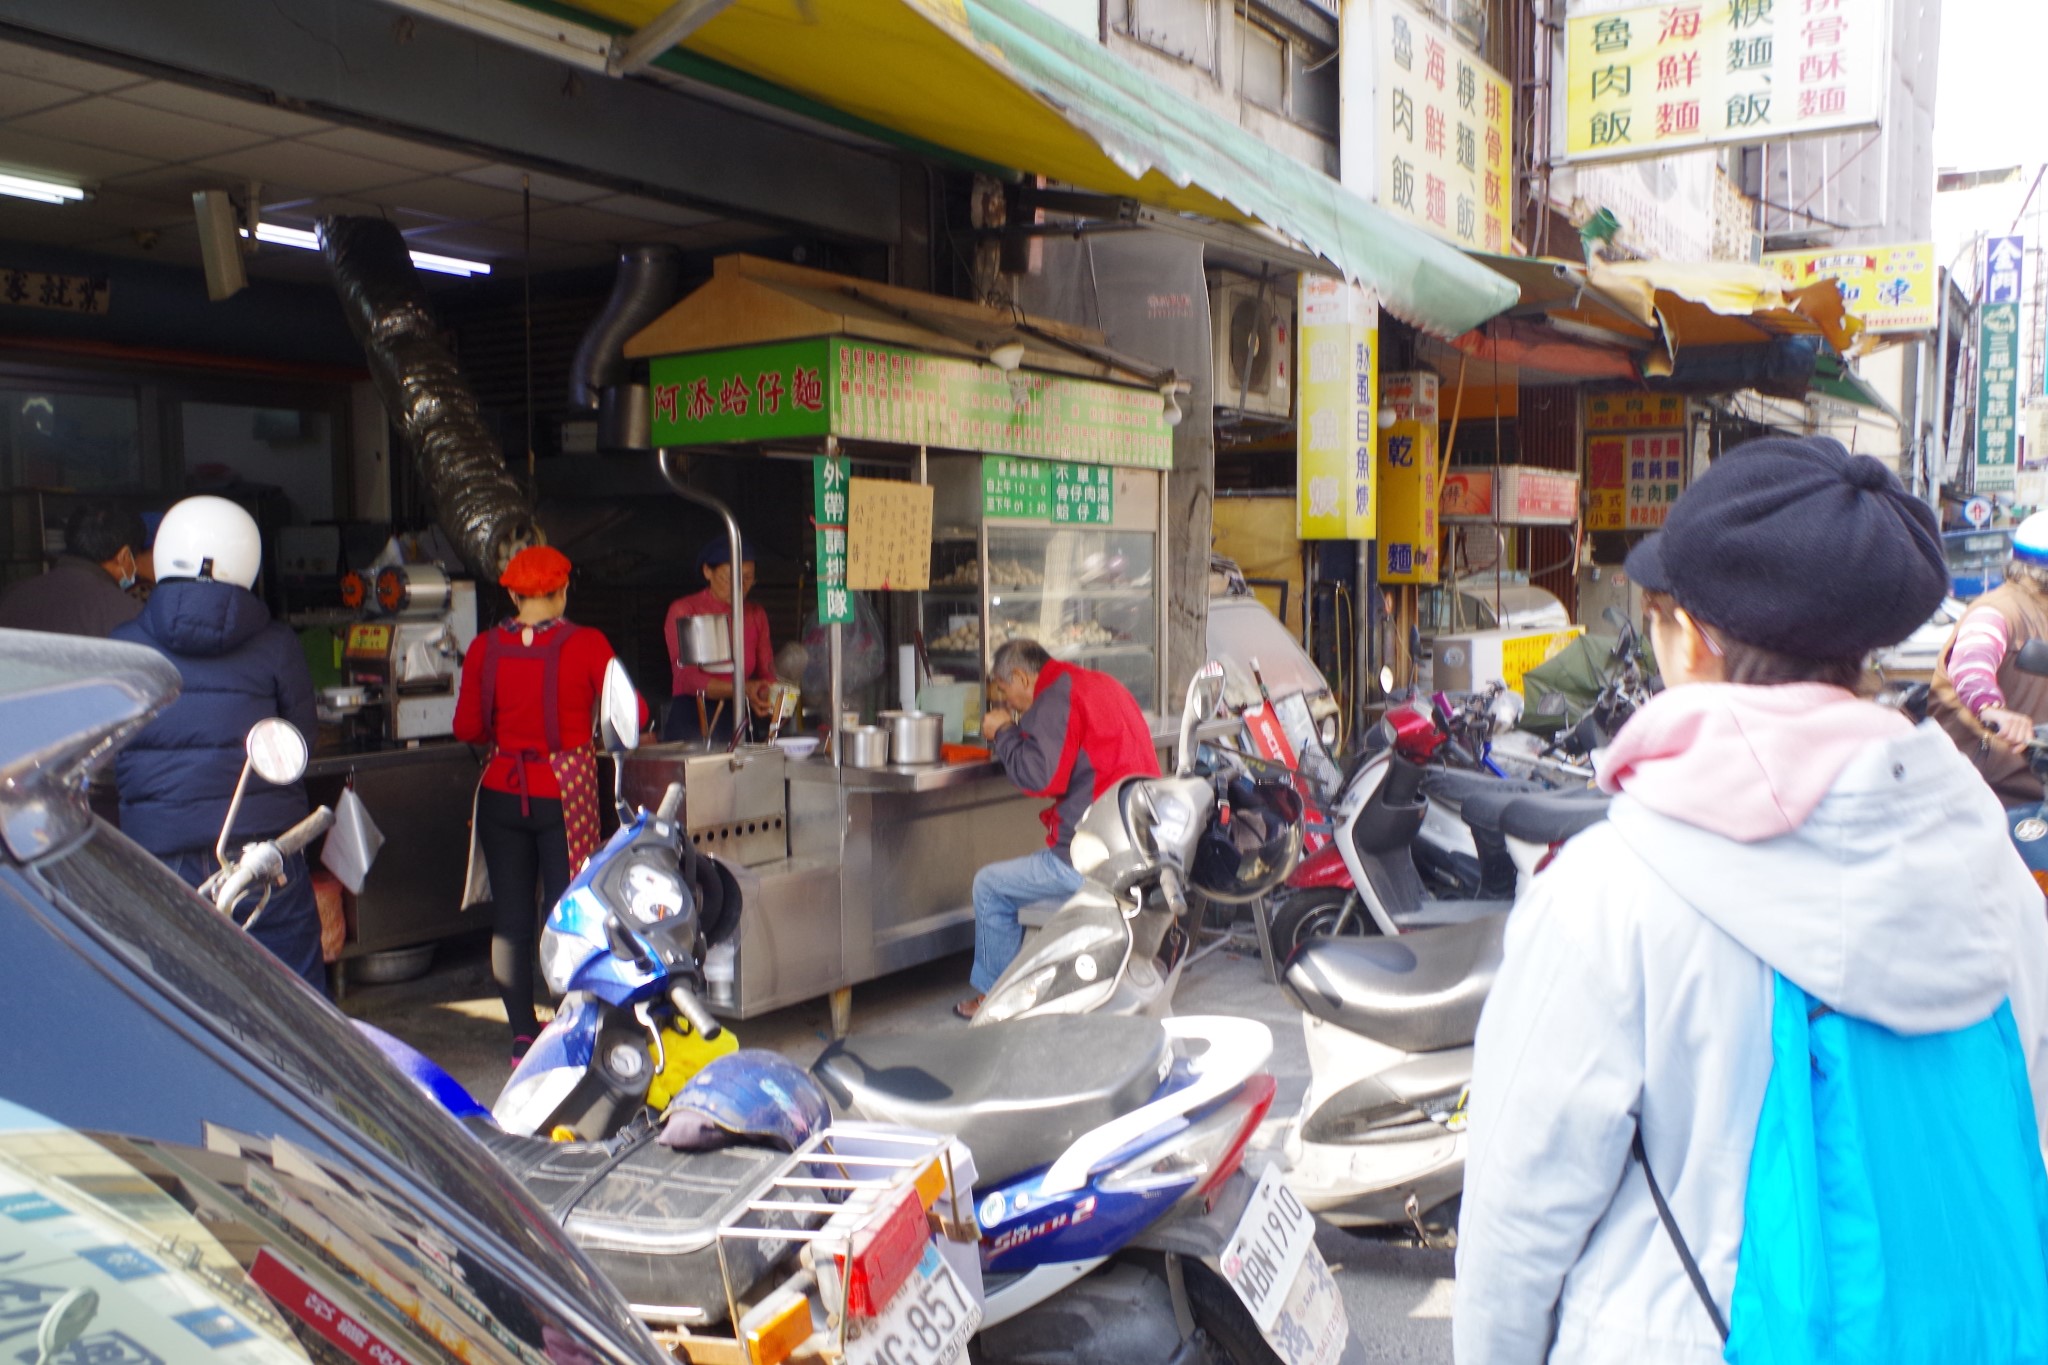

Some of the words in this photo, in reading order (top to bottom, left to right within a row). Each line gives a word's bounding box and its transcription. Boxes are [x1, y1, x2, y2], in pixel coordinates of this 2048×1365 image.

[1425, 33, 1446, 229] 海鮮麵
[1590, 17, 1632, 147] 魯肉飯
[1655, 7, 1702, 138] 海鮮麵
[1484, 79, 1503, 255] 排骨酥麵
[654, 364, 823, 423] 阿添蛤仔麵
[823, 459, 847, 618] 外帶請排隊
[1388, 435, 1413, 575] 乾麵
[1632, 484, 1678, 503] 牛肉麵
[1071, 1195, 1096, 1226] 2
